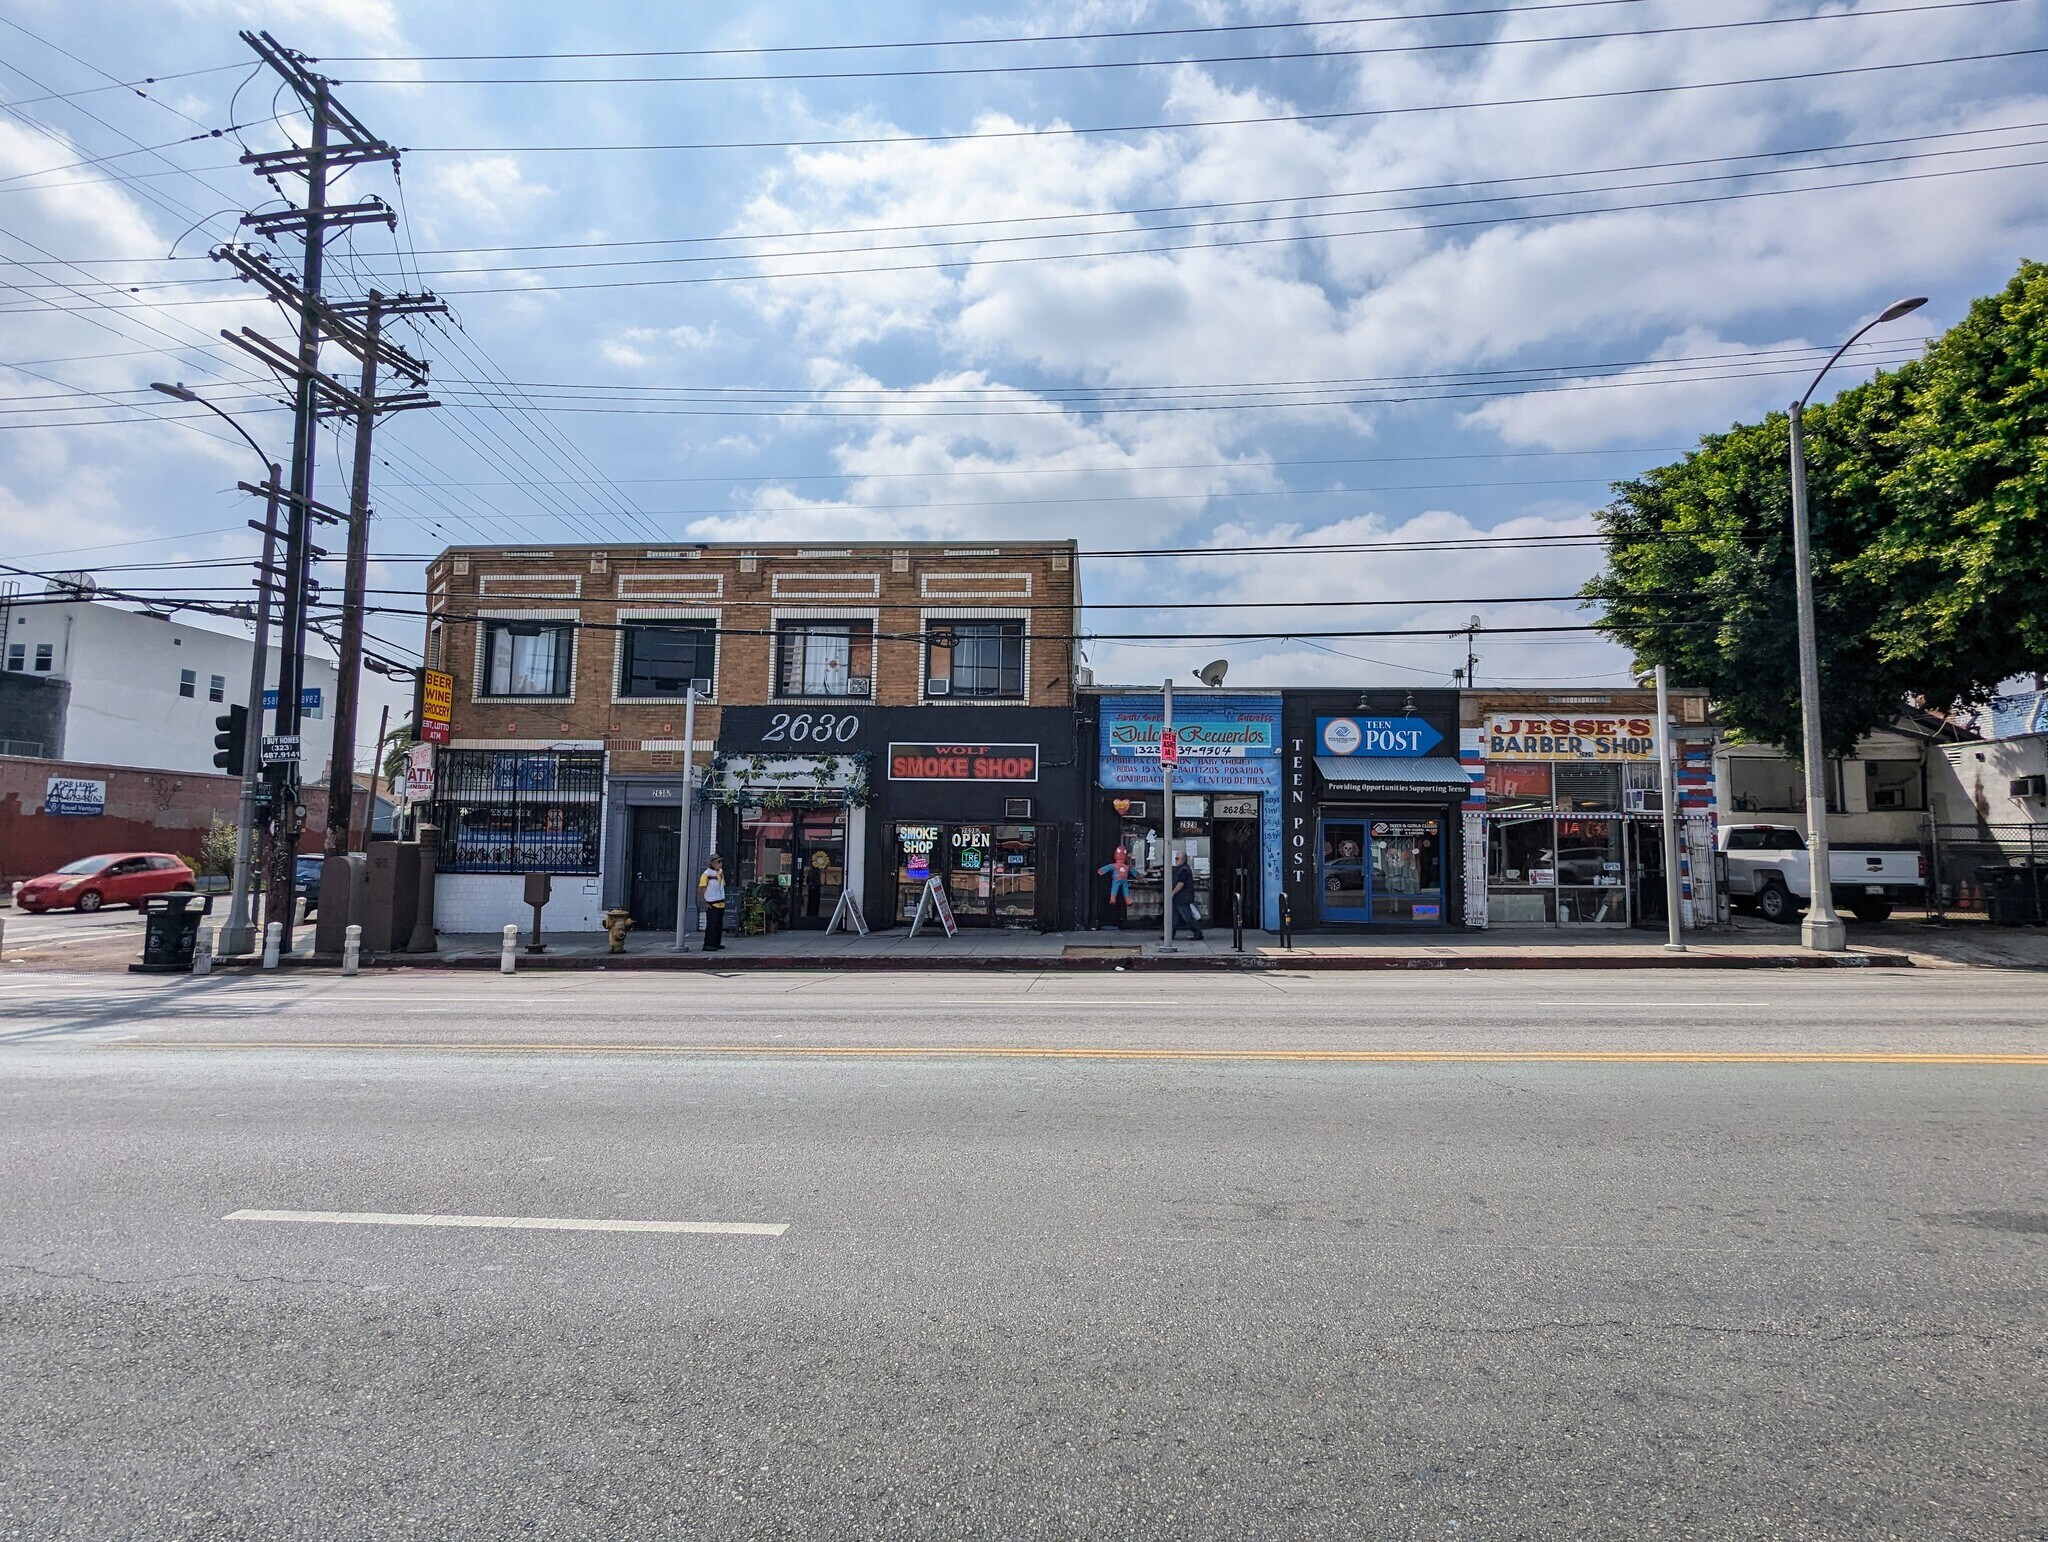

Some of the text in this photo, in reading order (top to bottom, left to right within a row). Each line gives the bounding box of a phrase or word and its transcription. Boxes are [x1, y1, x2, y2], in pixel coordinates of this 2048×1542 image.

[426, 672, 452, 689] BEER
[263, 696, 279, 705] esar
[426, 687, 451, 704] WINE
[424, 701, 451, 718] GROCERY
[762, 712, 859, 743] 2630
[1365, 720, 1392, 729] TEEN
[1494, 718, 1651, 736] JESSE'S
[267, 737, 279, 745] BUY
[279, 736, 300, 744] HOMES
[429, 731, 441, 740] ATM
[1112, 724, 1264, 744] Dulc Recuerdos
[1365, 730, 1422, 751] POST
[934, 746, 992, 756] WOLF
[1490, 736, 1654, 755] BARBER SHOP
[891, 756, 1034, 779] SMOKE SHOP
[1234, 777, 1245, 785] DE
[1328, 783, 1466, 794] Providing Opportunities Supporting Teens
[1291, 738, 1304, 882] TEEN POST
[899, 826, 938, 840] SMOKE
[951, 833, 991, 847] OPEN
[903, 840, 934, 854] SHOP
[964, 853, 980, 862] TRE
